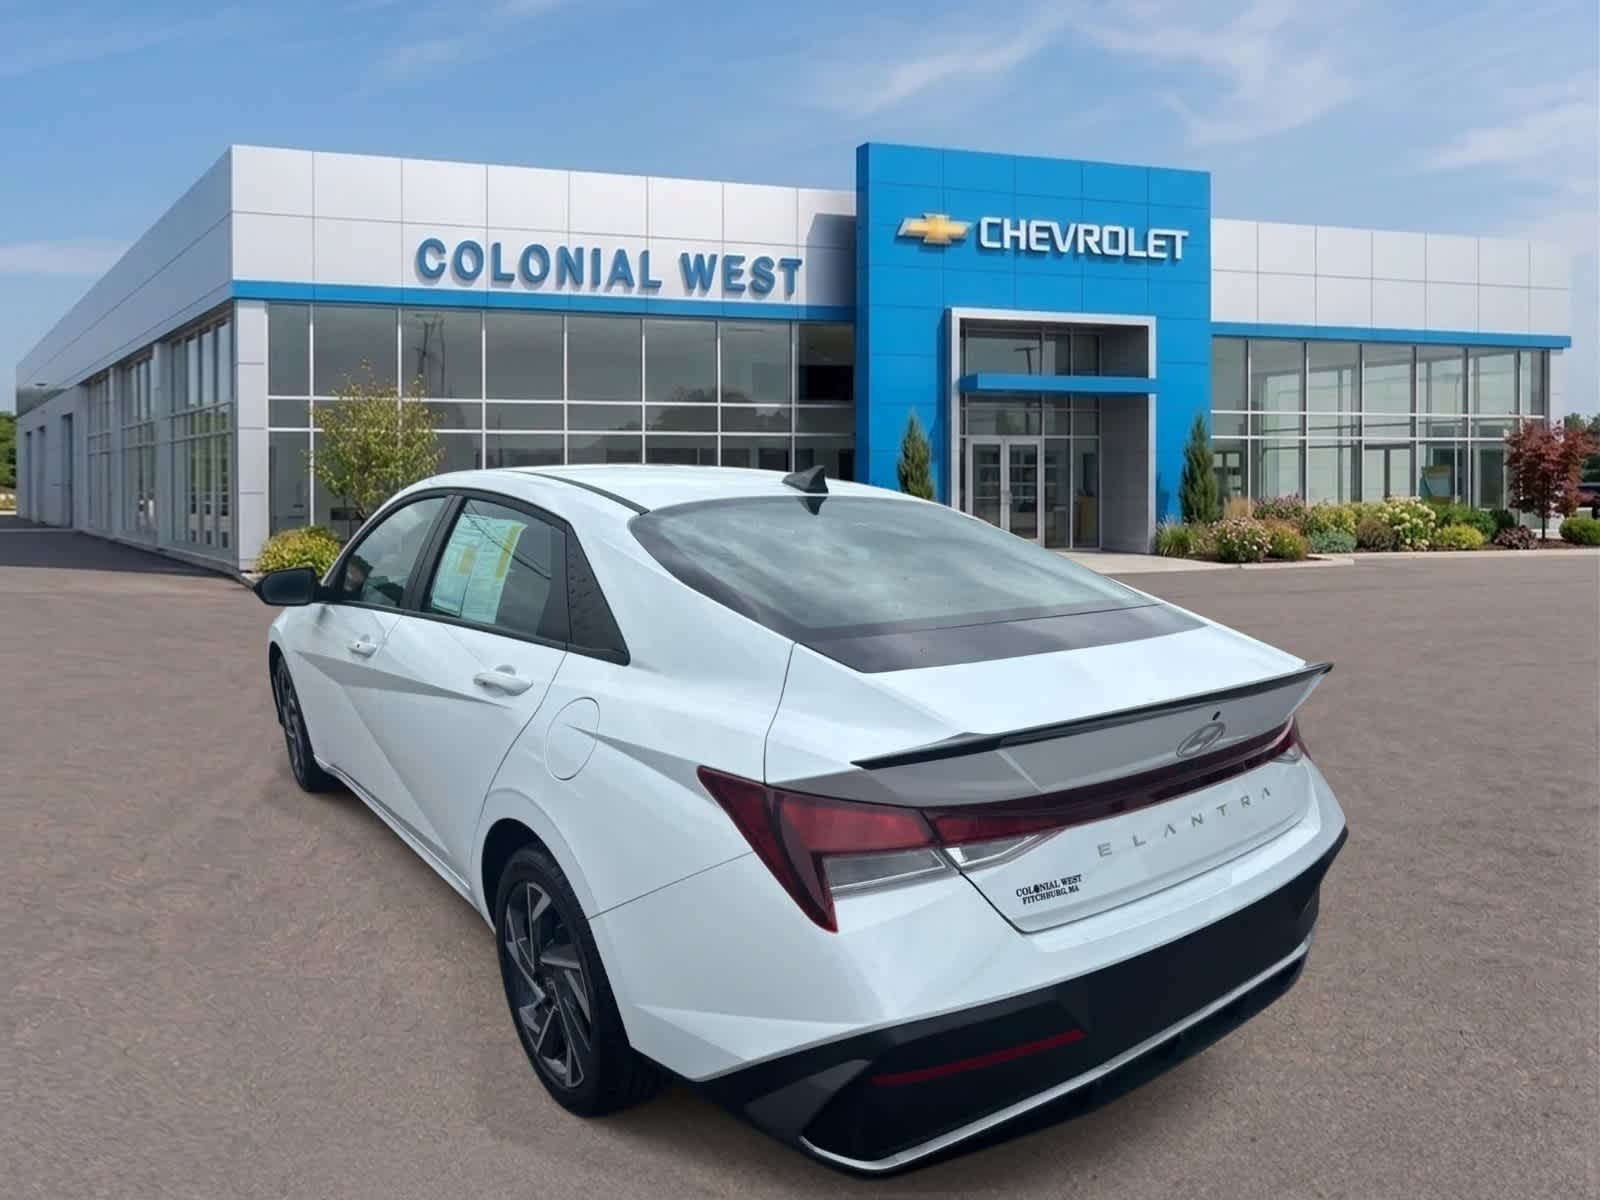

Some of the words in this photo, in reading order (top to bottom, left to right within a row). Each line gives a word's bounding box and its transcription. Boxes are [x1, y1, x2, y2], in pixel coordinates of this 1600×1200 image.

[980, 216, 1189, 260] CHEVROLET
[415, 237, 662, 290] COLONIAL
[680, 252, 803, 295] WEST
[1097, 786, 1271, 857] ELANTRA
[1015, 880, 1060, 897] COLONIAL
[1060, 873, 1082, 886] WEST
[1068, 885, 1080, 894] MA
